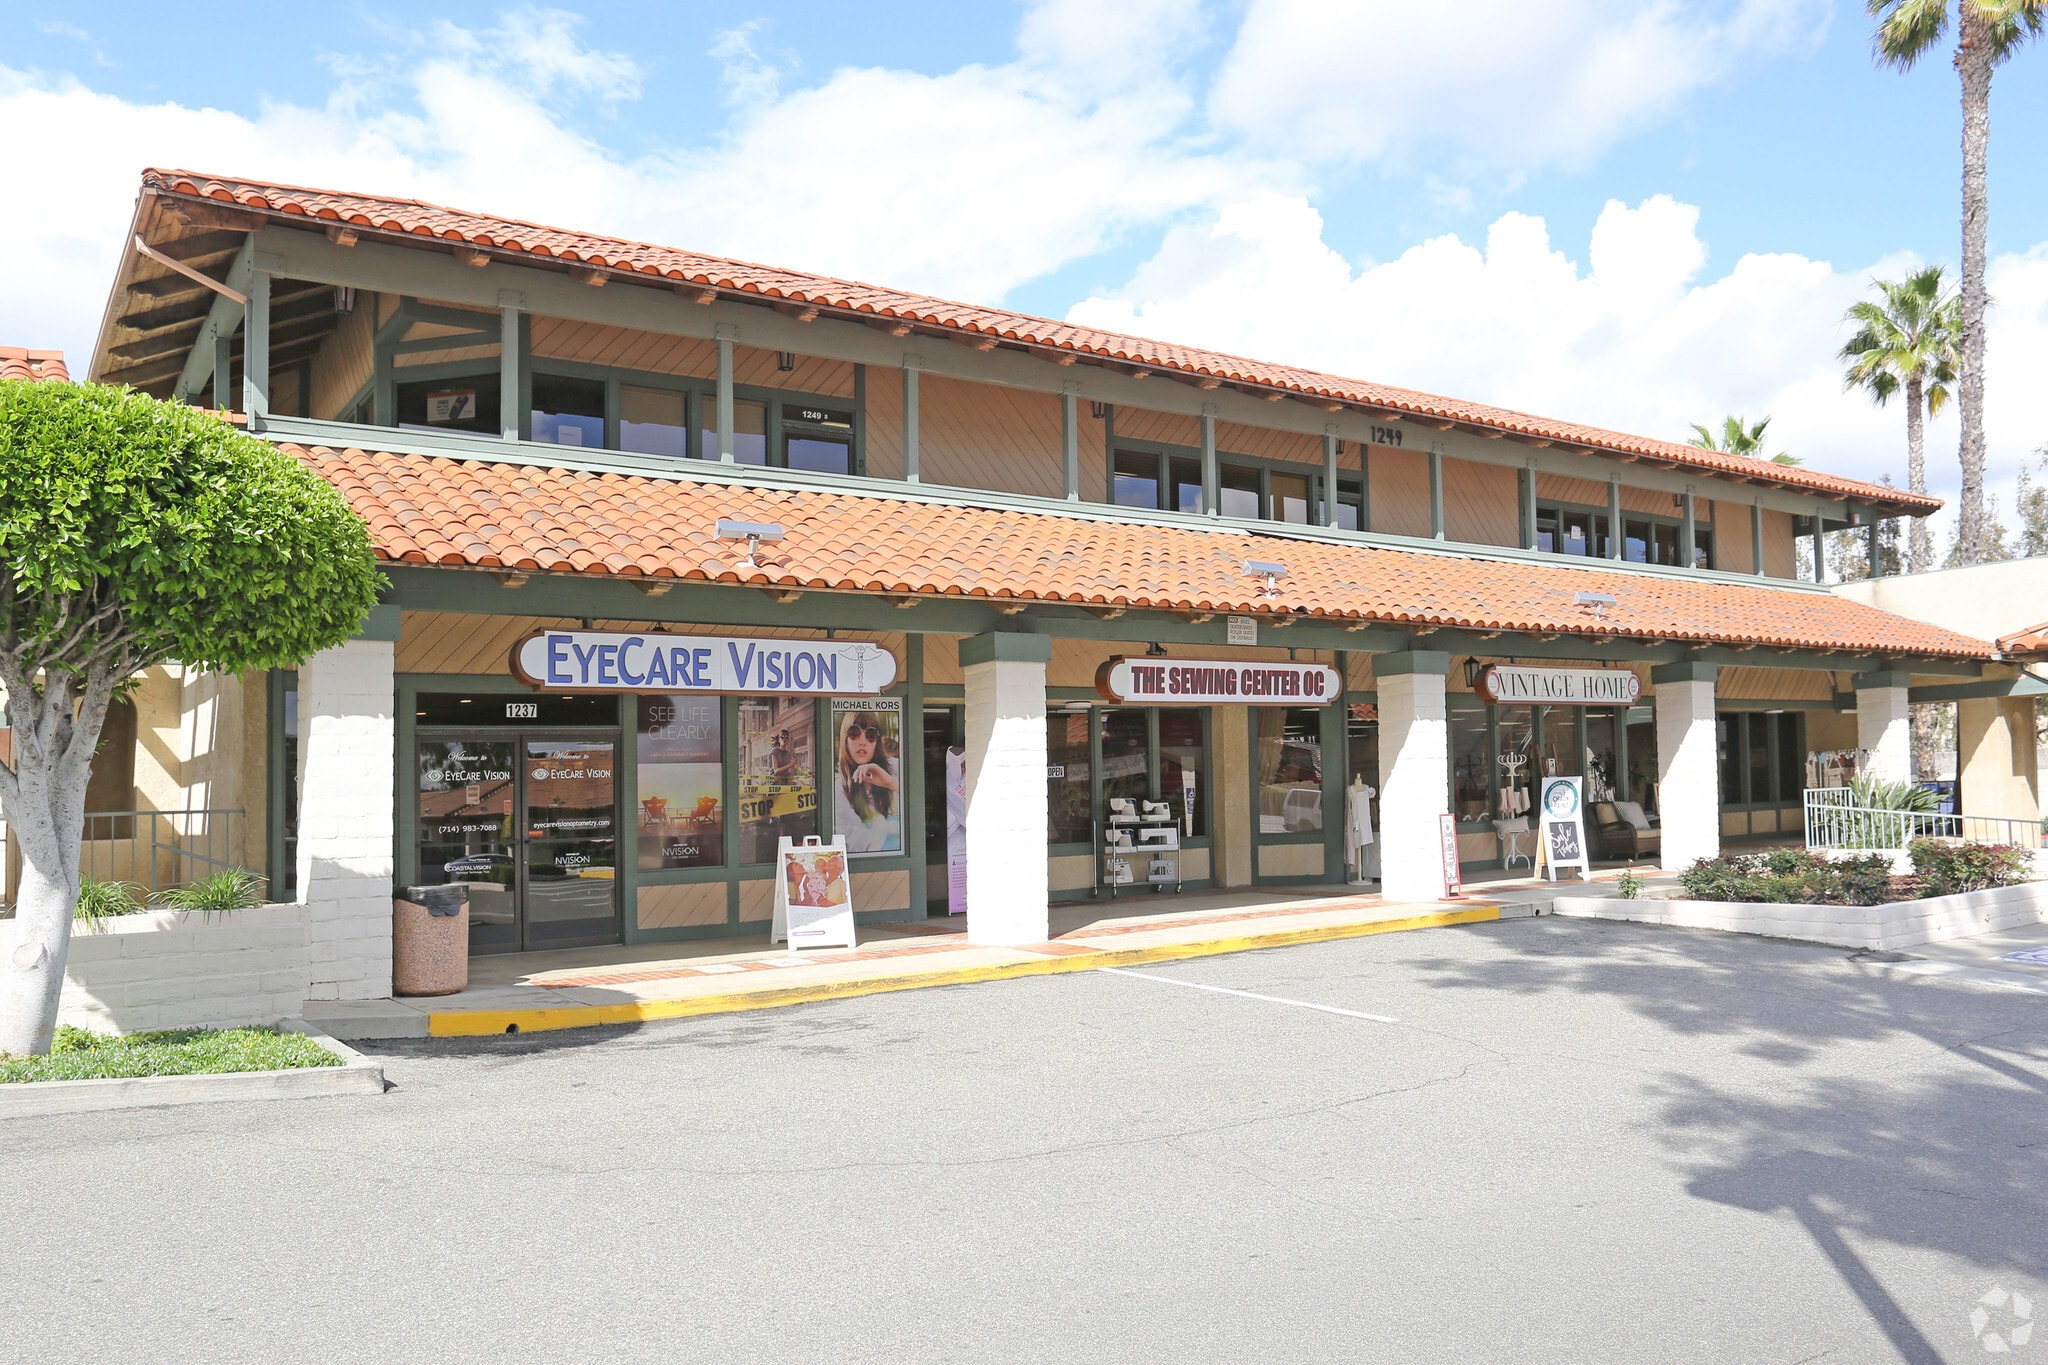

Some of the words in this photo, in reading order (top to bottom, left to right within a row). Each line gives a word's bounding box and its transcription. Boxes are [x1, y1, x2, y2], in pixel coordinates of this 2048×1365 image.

[802, 411, 821, 420] 1249
[1371, 425, 1402, 446] 1249
[1131, 666, 1165, 694] THE
[1168, 666, 1237, 695] SEWING
[1240, 668, 1300, 696] CENTER
[1303, 670, 1325, 696] OC
[1499, 673, 1574, 698] VINTAGE
[1583, 676, 1628, 699] HOME
[508, 704, 535, 717] 1237
[832, 701, 872, 709] MICHAEL
[875, 701, 899, 709] KORS
[649, 706, 676, 722] SEE
[681, 706, 709, 722] LIFE
[648, 725, 710, 740] CLEARLY
[448, 751, 478, 761] Welcome
[553, 750, 581, 760] Welcome
[1048, 767, 1063, 777] OPEN
[741, 800, 774, 819] STOP
[438, 825, 460, 834] (714)
[533, 819, 610, 829] eyecarevisionoptometry.com
[1551, 823, 1572, 849] Sale
[661, 846, 699, 857] NVISION
[555, 856, 591, 864] NVISION
